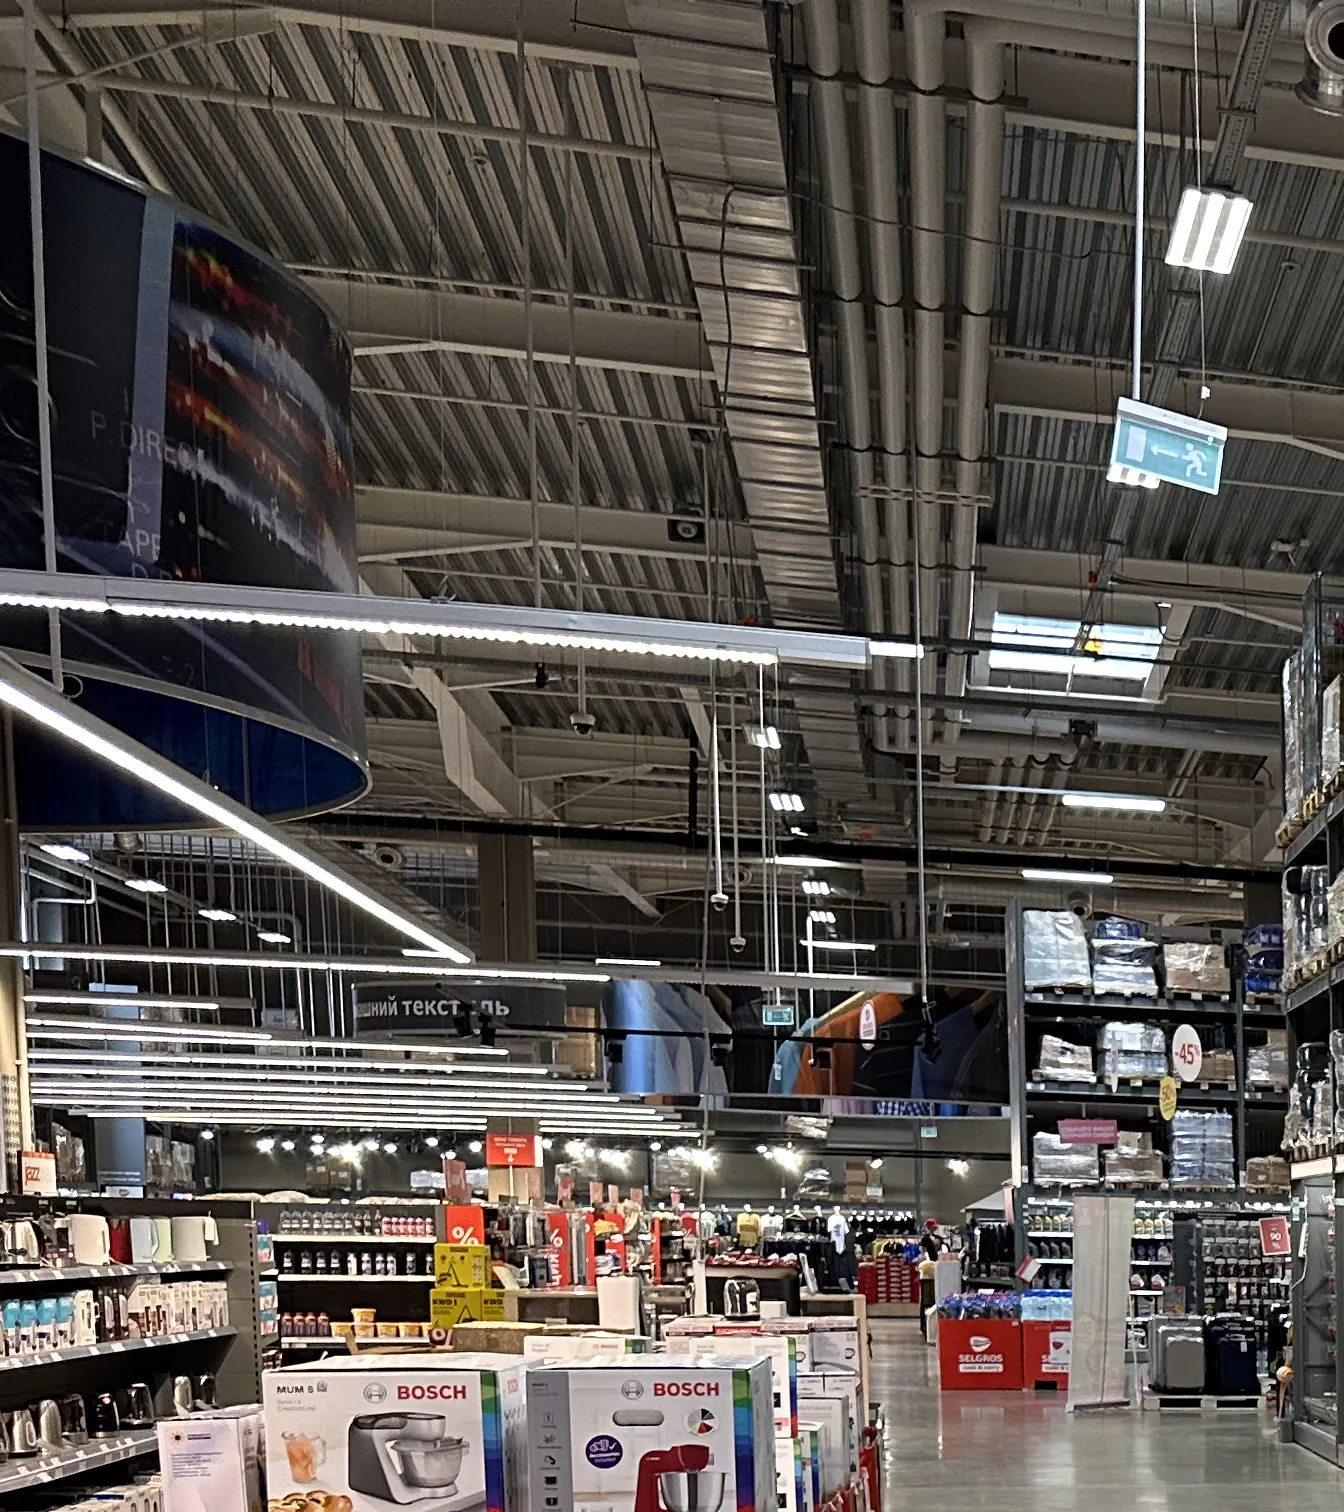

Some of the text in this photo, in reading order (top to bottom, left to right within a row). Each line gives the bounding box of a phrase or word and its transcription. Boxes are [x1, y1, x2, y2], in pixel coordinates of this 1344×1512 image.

[276, 1385, 304, 1395] MUM
[397, 1385, 467, 1400] BOSCH
[653, 1382, 720, 1397] BOSCH
